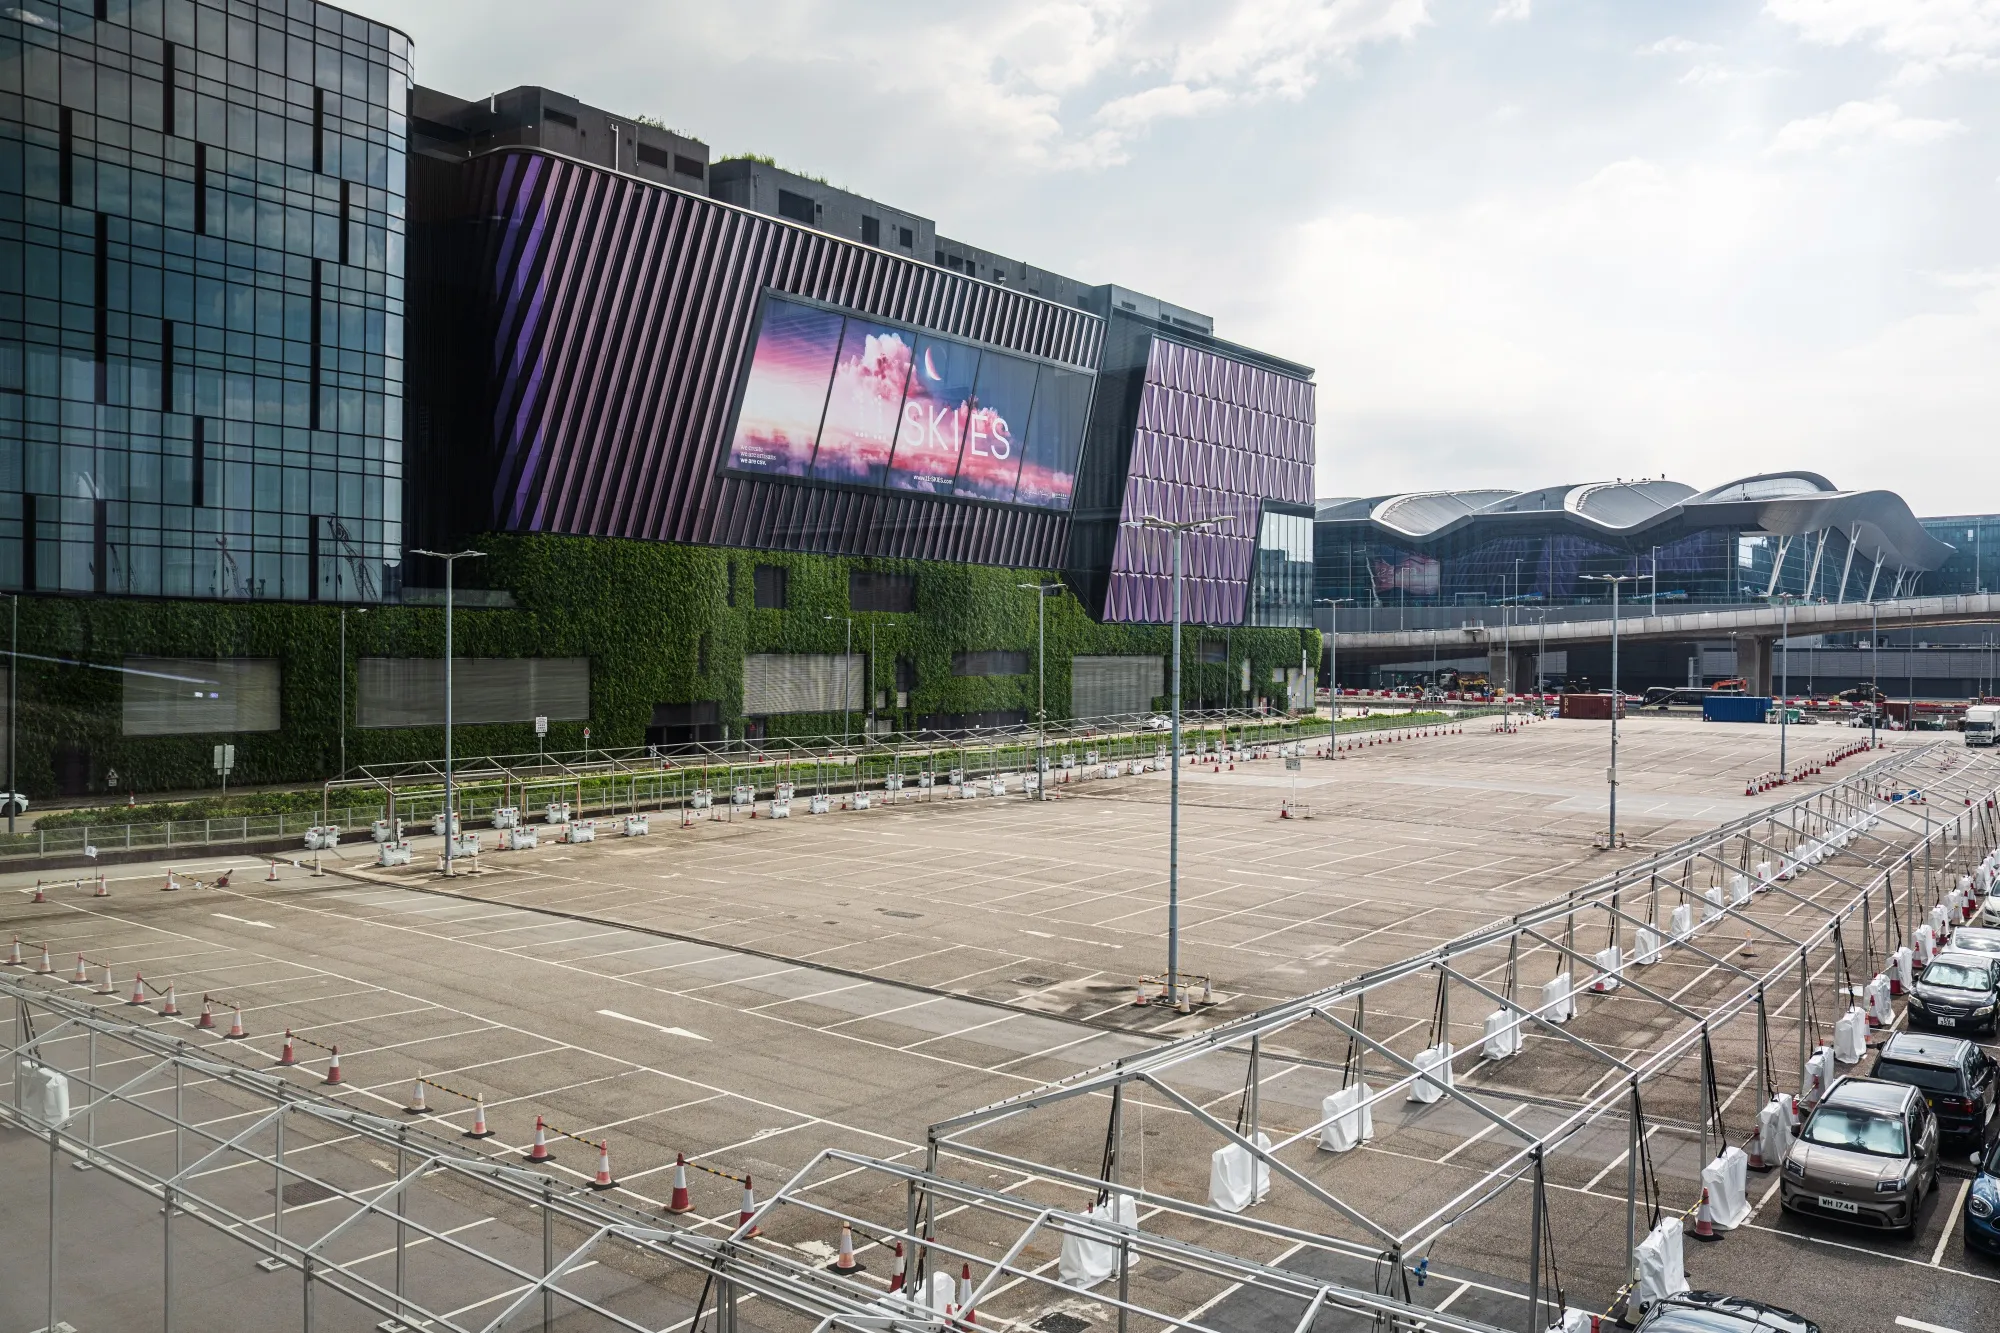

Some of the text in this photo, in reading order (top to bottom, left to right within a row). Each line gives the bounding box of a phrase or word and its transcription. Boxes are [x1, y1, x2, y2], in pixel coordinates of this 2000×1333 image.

[904, 401, 1010, 460] SKIES
[1822, 1199, 1854, 1211] WH 1744
